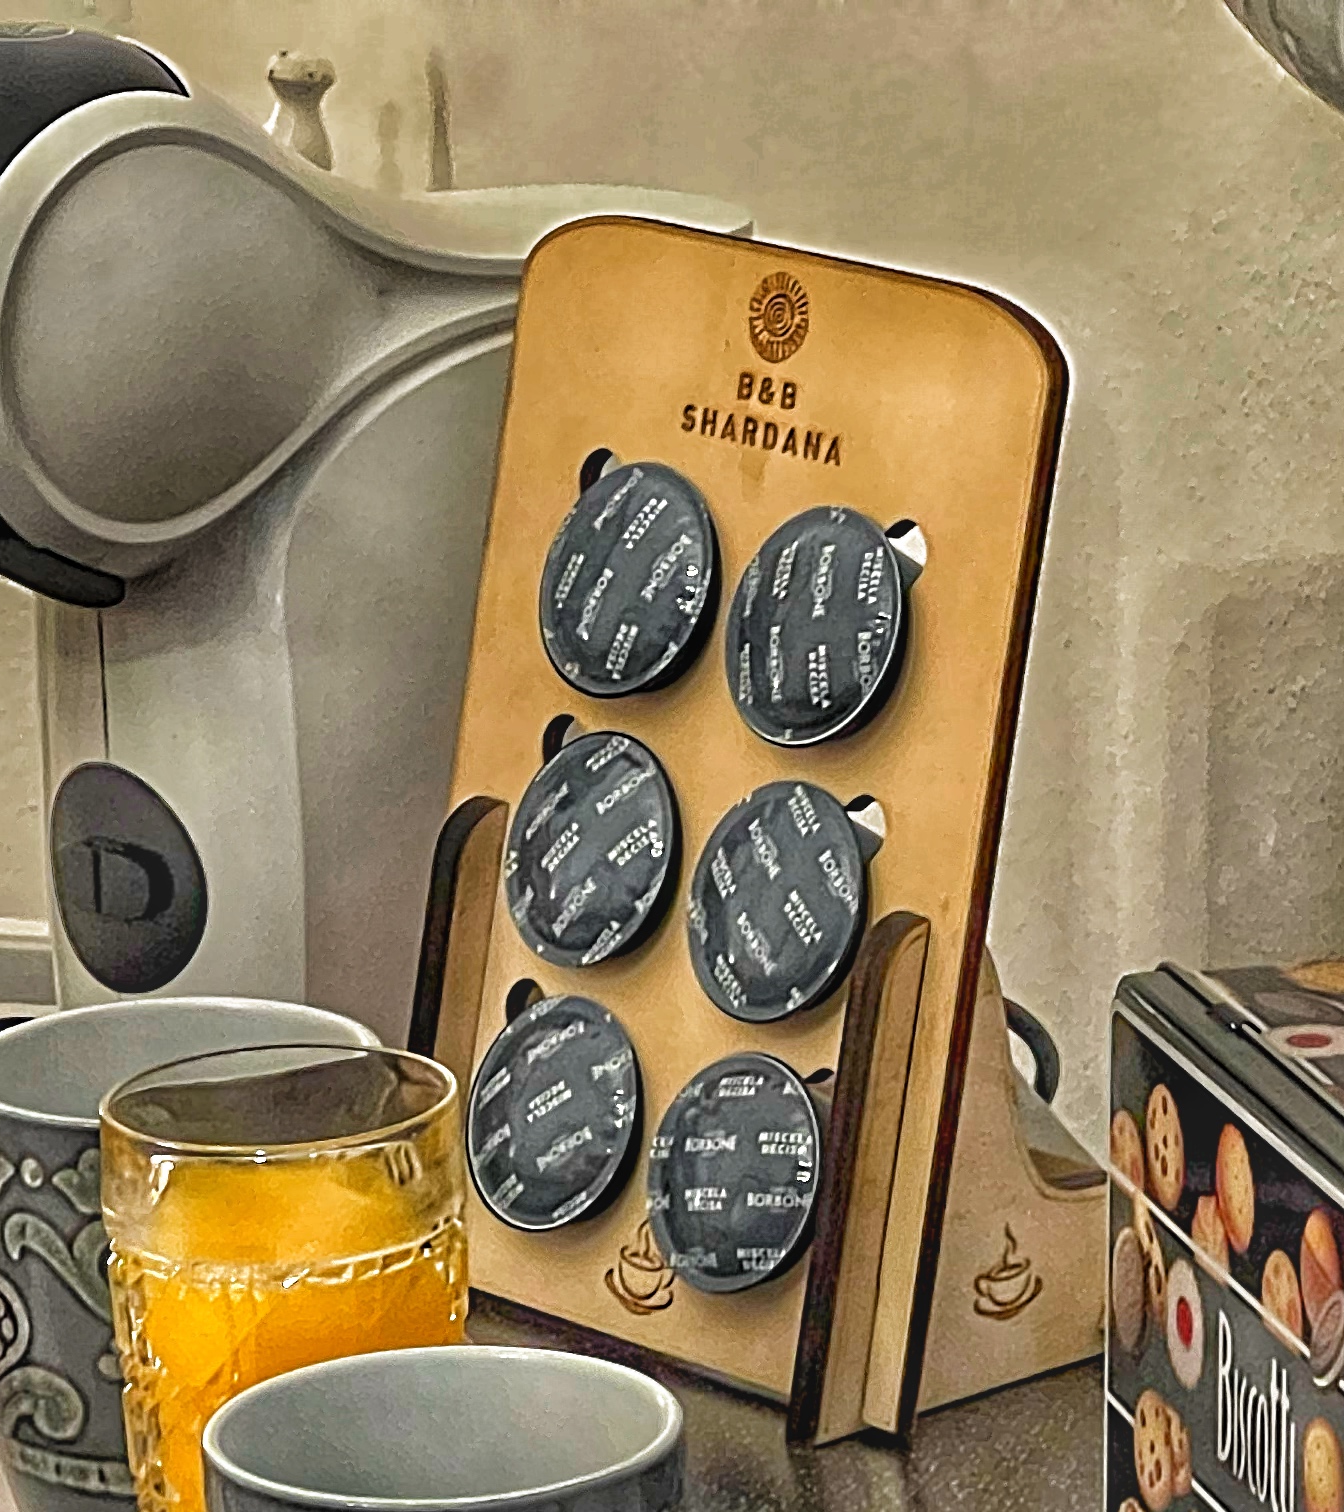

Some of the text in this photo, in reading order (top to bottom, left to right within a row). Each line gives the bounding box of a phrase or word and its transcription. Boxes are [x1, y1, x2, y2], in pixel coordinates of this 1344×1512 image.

[737, 372, 797, 409] B&B
[681, 404, 841, 467] SHARDANA
[758, 1132, 812, 1144] MISCELA
[761, 1144, 808, 1155] DECISA
[684, 1187, 727, 1199] MISCELA
[747, 1192, 813, 1208] BORBONE
